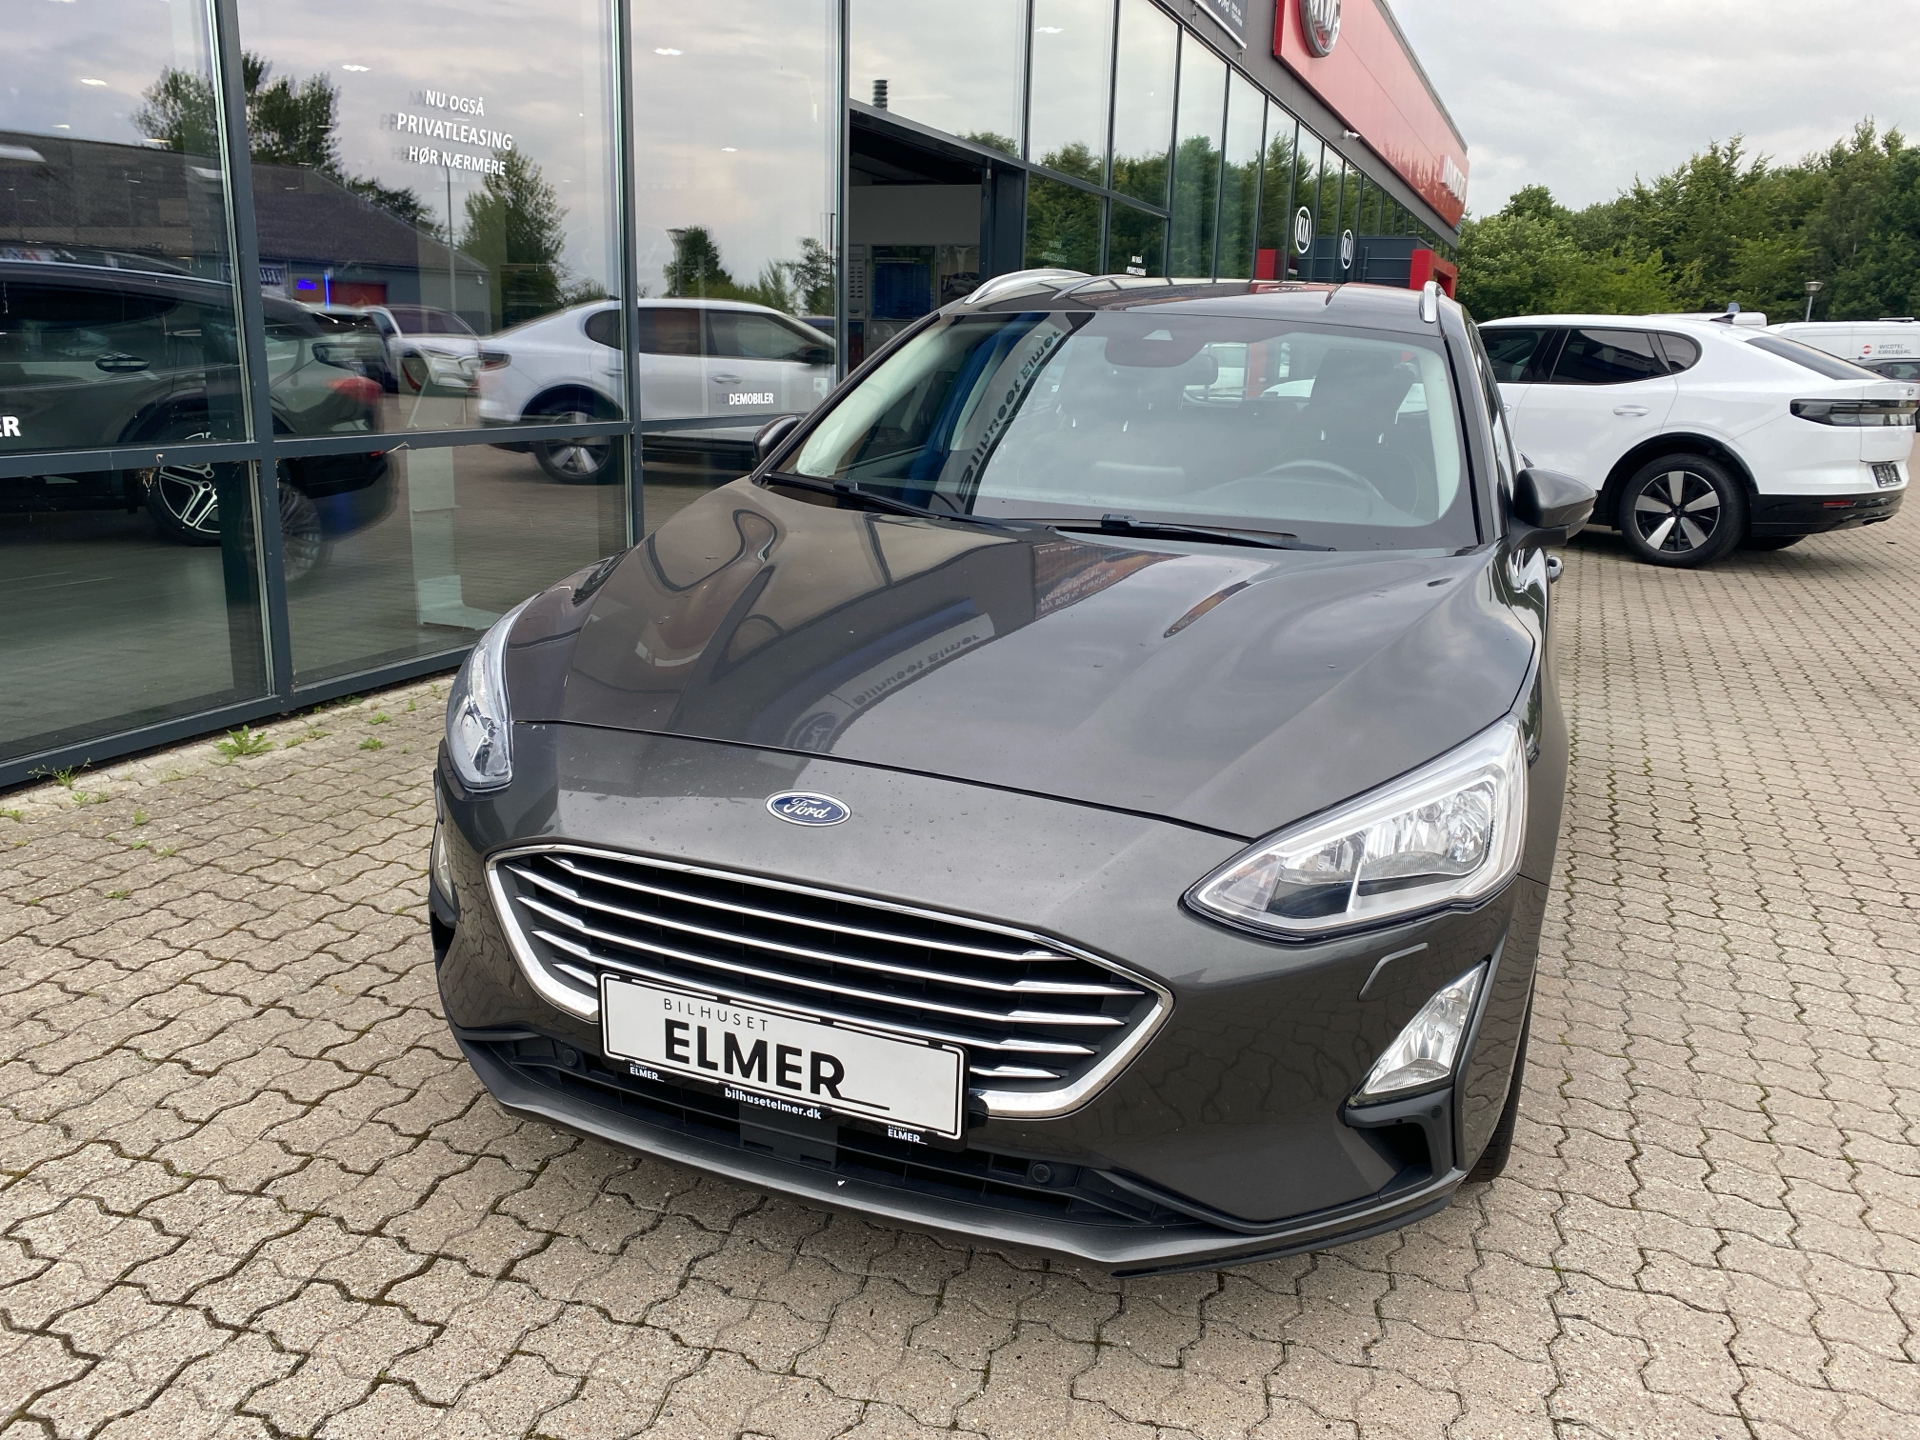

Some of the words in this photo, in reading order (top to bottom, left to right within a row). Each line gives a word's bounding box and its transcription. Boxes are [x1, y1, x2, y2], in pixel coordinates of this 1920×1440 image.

[425, 89, 446, 108] NU
[449, 96, 485, 117] OGSÅ
[396, 112, 513, 151] PRIVATLEASING
[408, 145, 438, 165] HØR
[441, 151, 507, 176] NÆRMERE
[729, 392, 774, 406] DEMOBILER
[0, 415, 21, 438] R
[782, 797, 832, 819] Ford
[663, 998, 769, 1032] BILHUSET
[664, 1018, 850, 1100] ELMER
[629, 1066, 660, 1081] ELMER
[724, 1087, 822, 1120] bilhusetelmer.dk
[887, 1128, 922, 1143] ELMER
